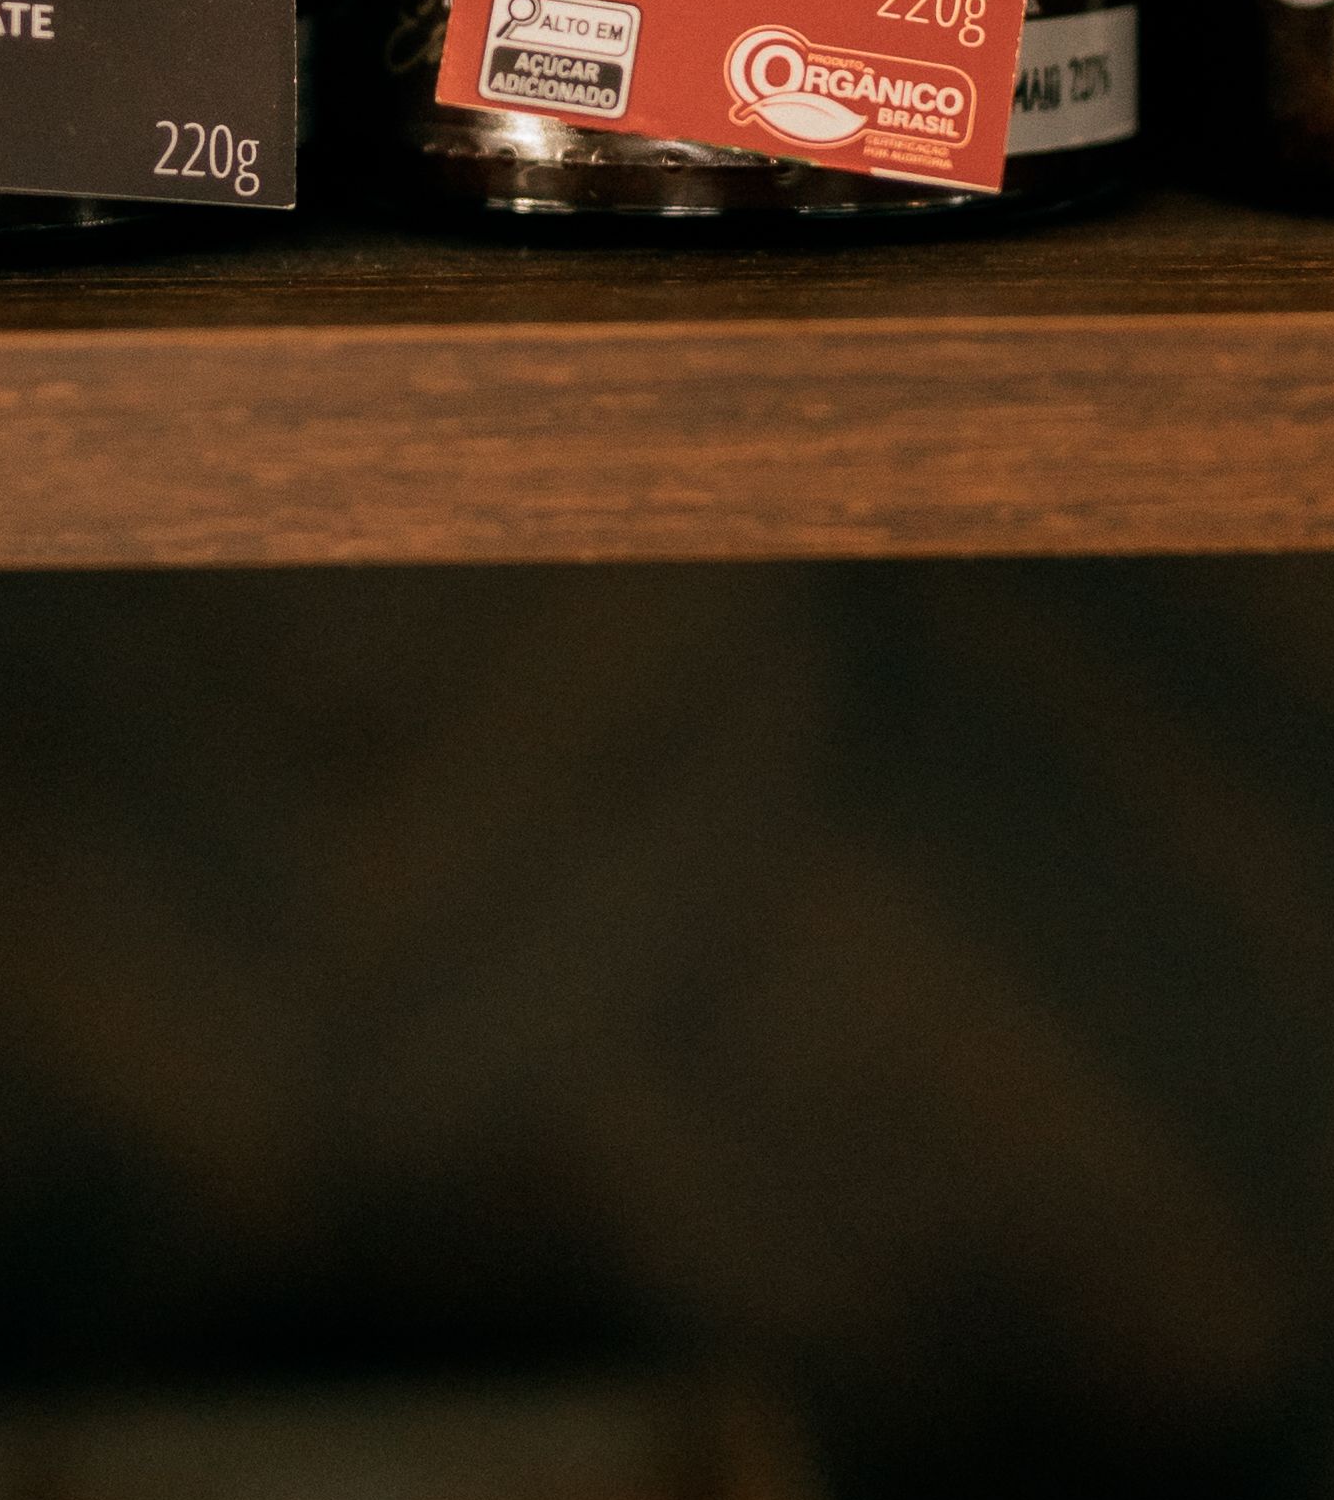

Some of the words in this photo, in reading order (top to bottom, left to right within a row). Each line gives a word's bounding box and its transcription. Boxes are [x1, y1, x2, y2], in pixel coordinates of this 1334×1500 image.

[539, 14, 590, 37] ALTO
[596, 21, 624, 42] EM
[490, 71, 618, 110] ADICIONADO
[750, 43, 965, 117] ORGÂNICO
[876, 106, 961, 139] BRASIL
[152, 119, 262, 198] 220g
